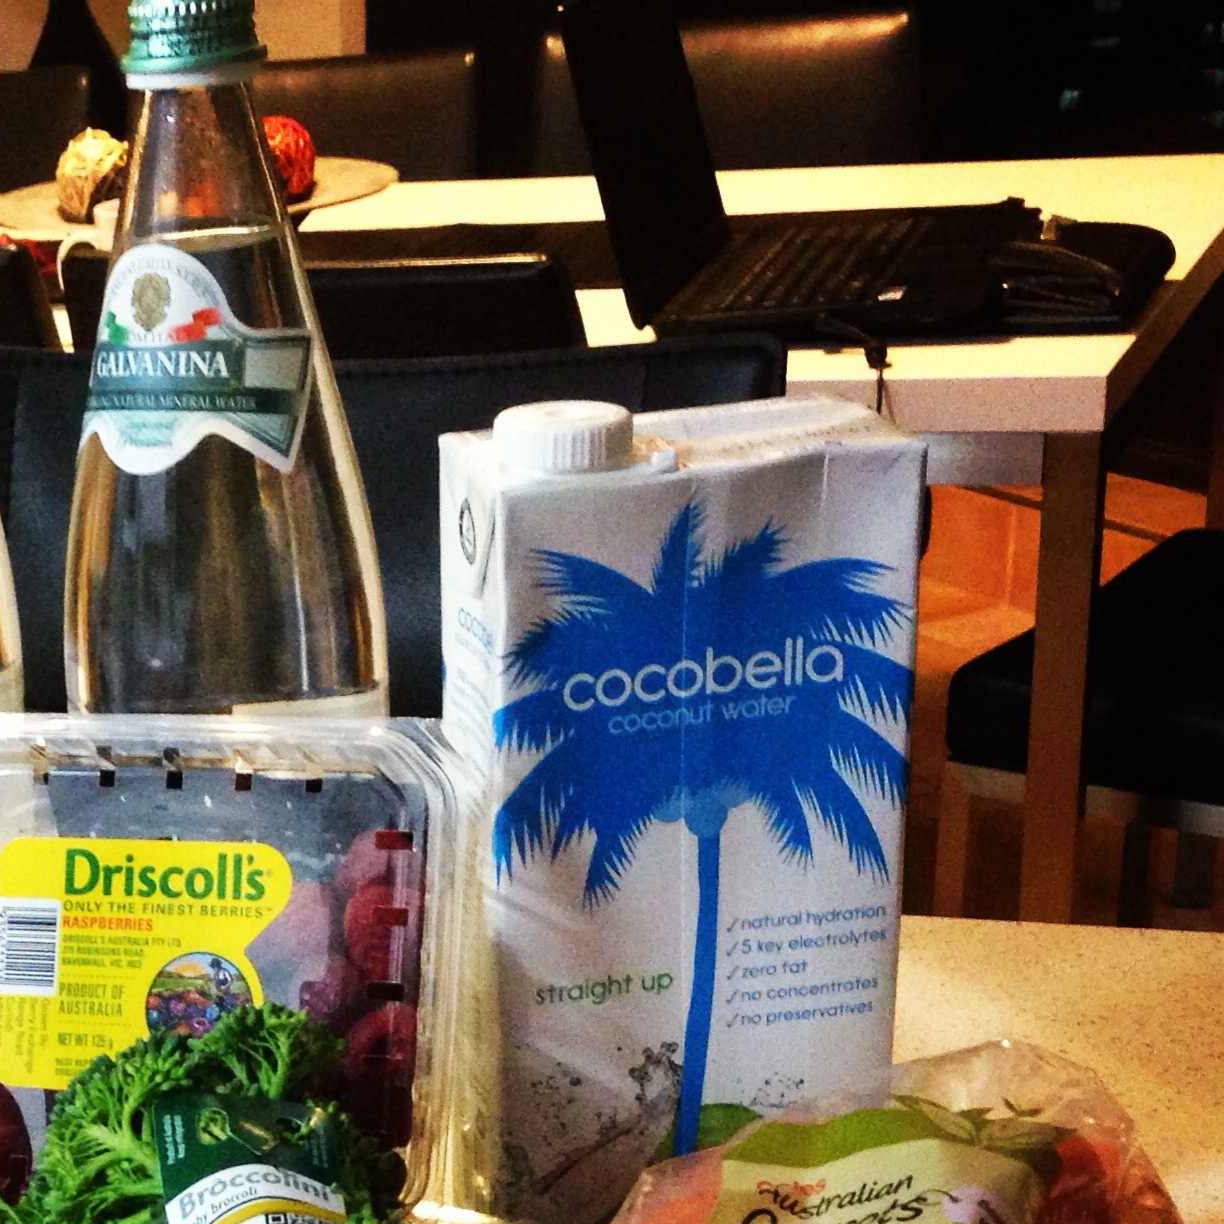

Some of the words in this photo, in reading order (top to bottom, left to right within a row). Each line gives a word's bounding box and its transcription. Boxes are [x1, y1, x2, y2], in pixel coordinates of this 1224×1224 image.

[95, 350, 229, 378] GALVANINA
[563, 635, 845, 711] cocobella
[608, 701, 714, 735] coconut
[721, 693, 797, 721] water
[63, 847, 266, 901] Driscoll's
[63, 899, 104, 914] ONLY
[109, 901, 137, 914] THE
[142, 902, 194, 916] FINEST
[741, 911, 803, 930] natural
[805, 905, 887, 929] hydration
[63, 915, 154, 932] RASPBERRIES
[741, 938, 752, 954] 5
[757, 938, 784, 956] key
[788, 928, 887, 951] electrolytes
[741, 963, 777, 979] zero
[782, 960, 809, 975] fat
[59, 982, 107, 999] PRODUCT
[111, 984, 125, 1000] OF
[535, 975, 633, 1007] straight
[641, 970, 674, 995] up
[741, 989, 762, 1002] no
[766, 977, 879, 1000] concentrates
[57, 999, 124, 1018] AUSTRALIA
[741, 1012, 762, 1026] no
[766, 1001, 874, 1026] preservatives
[57, 1032, 73, 1046] NET
[75, 1033, 89, 1047] WT
[210, 1186, 258, 1213] broccoli
[758, 1174, 914, 1219] Australian
